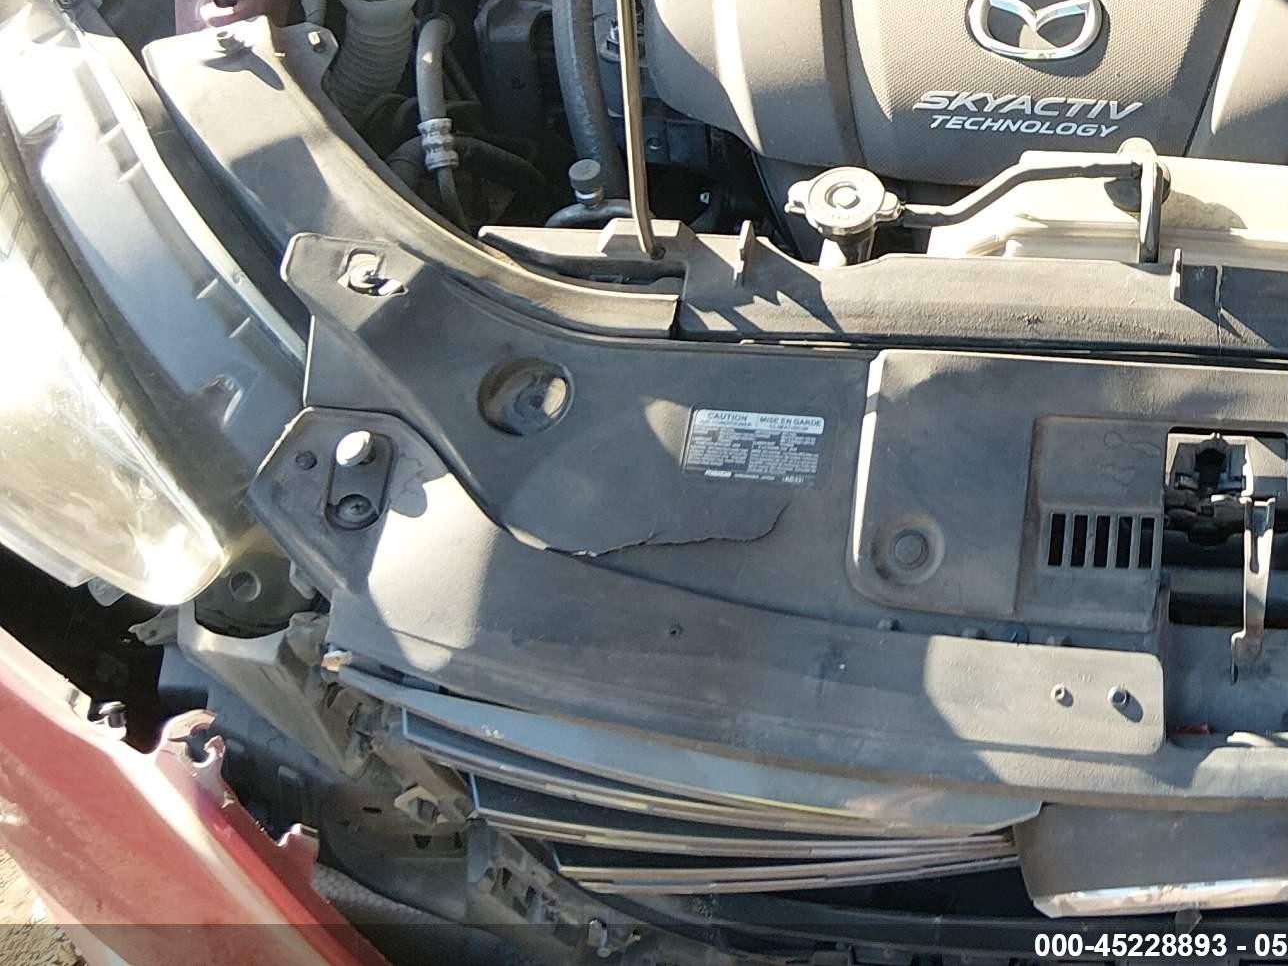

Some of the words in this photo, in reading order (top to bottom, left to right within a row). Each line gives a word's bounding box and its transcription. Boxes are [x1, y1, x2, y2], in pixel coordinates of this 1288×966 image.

[914, 91, 1143, 119] SKYACTIV
[930, 115, 1119, 137] TECHNOLOGY
[708, 412, 748, 422] CAUTION
